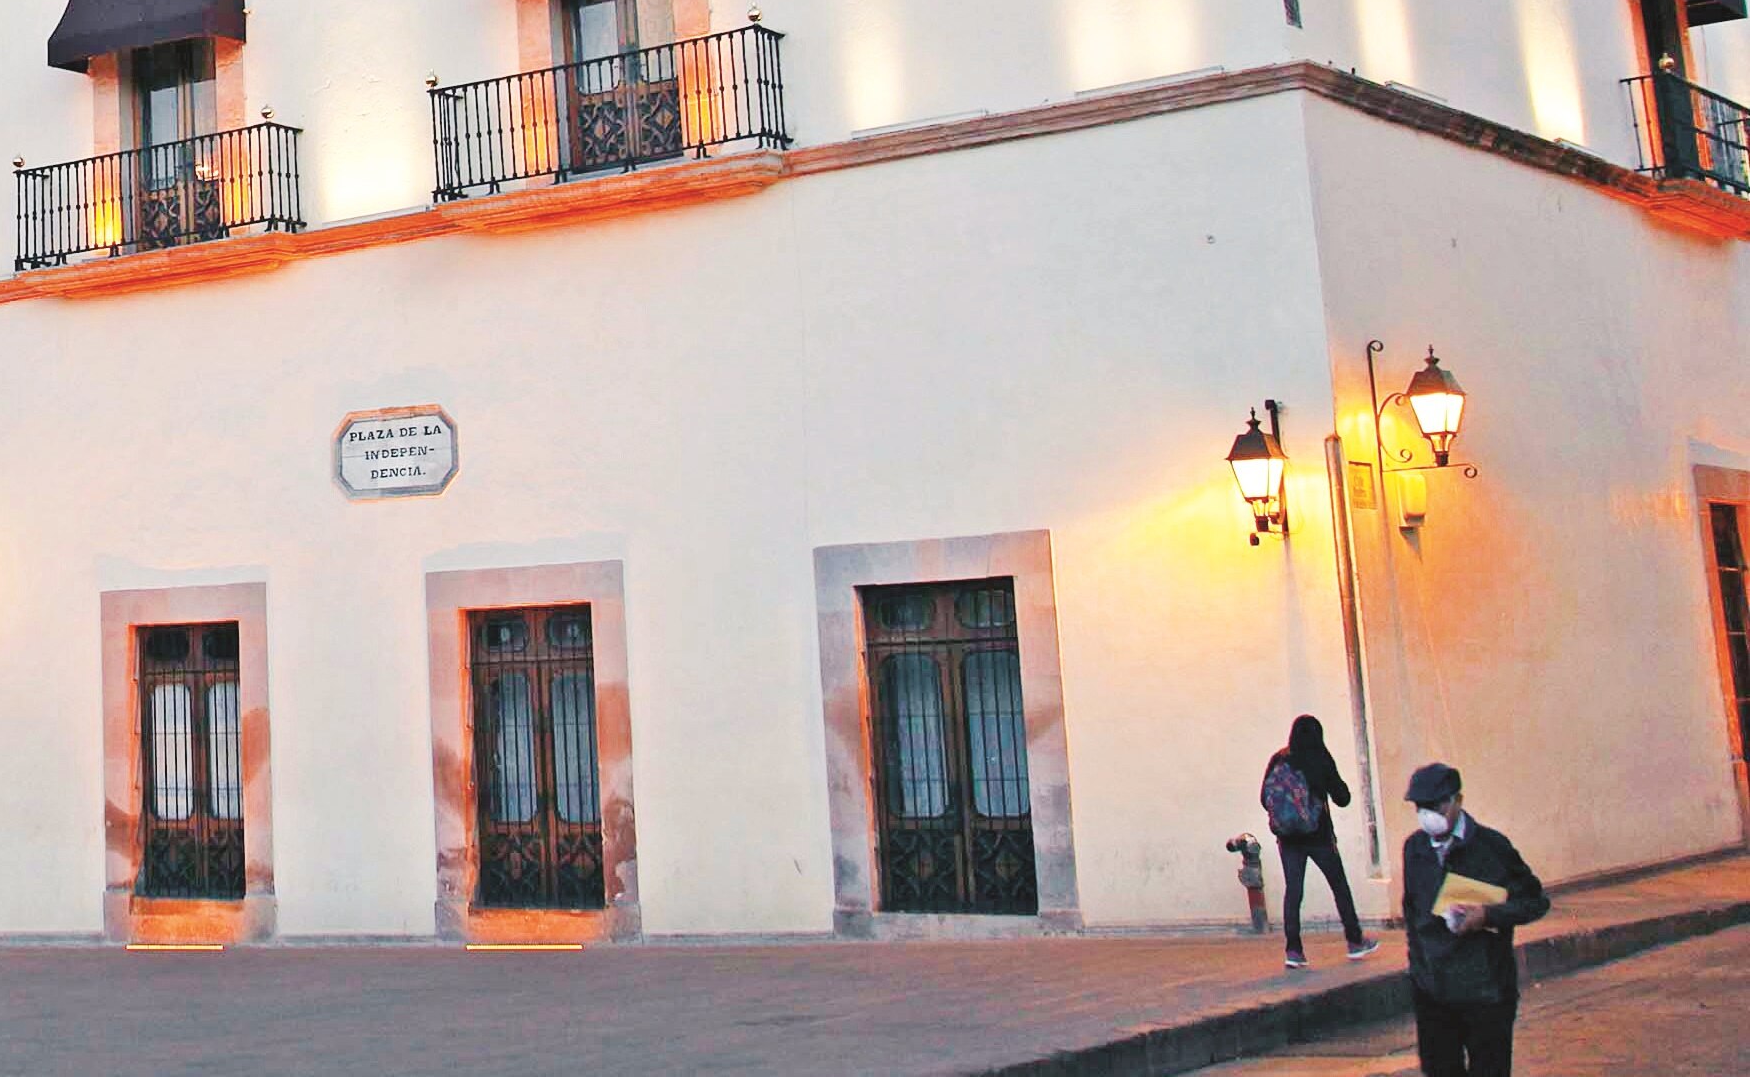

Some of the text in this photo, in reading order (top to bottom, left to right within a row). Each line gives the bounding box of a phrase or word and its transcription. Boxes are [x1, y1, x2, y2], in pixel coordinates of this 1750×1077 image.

[349, 425, 442, 442] PLAZA DE LA
[364, 445, 435, 460] INDEPEN-
[370, 466, 427, 480] DENCIA.
